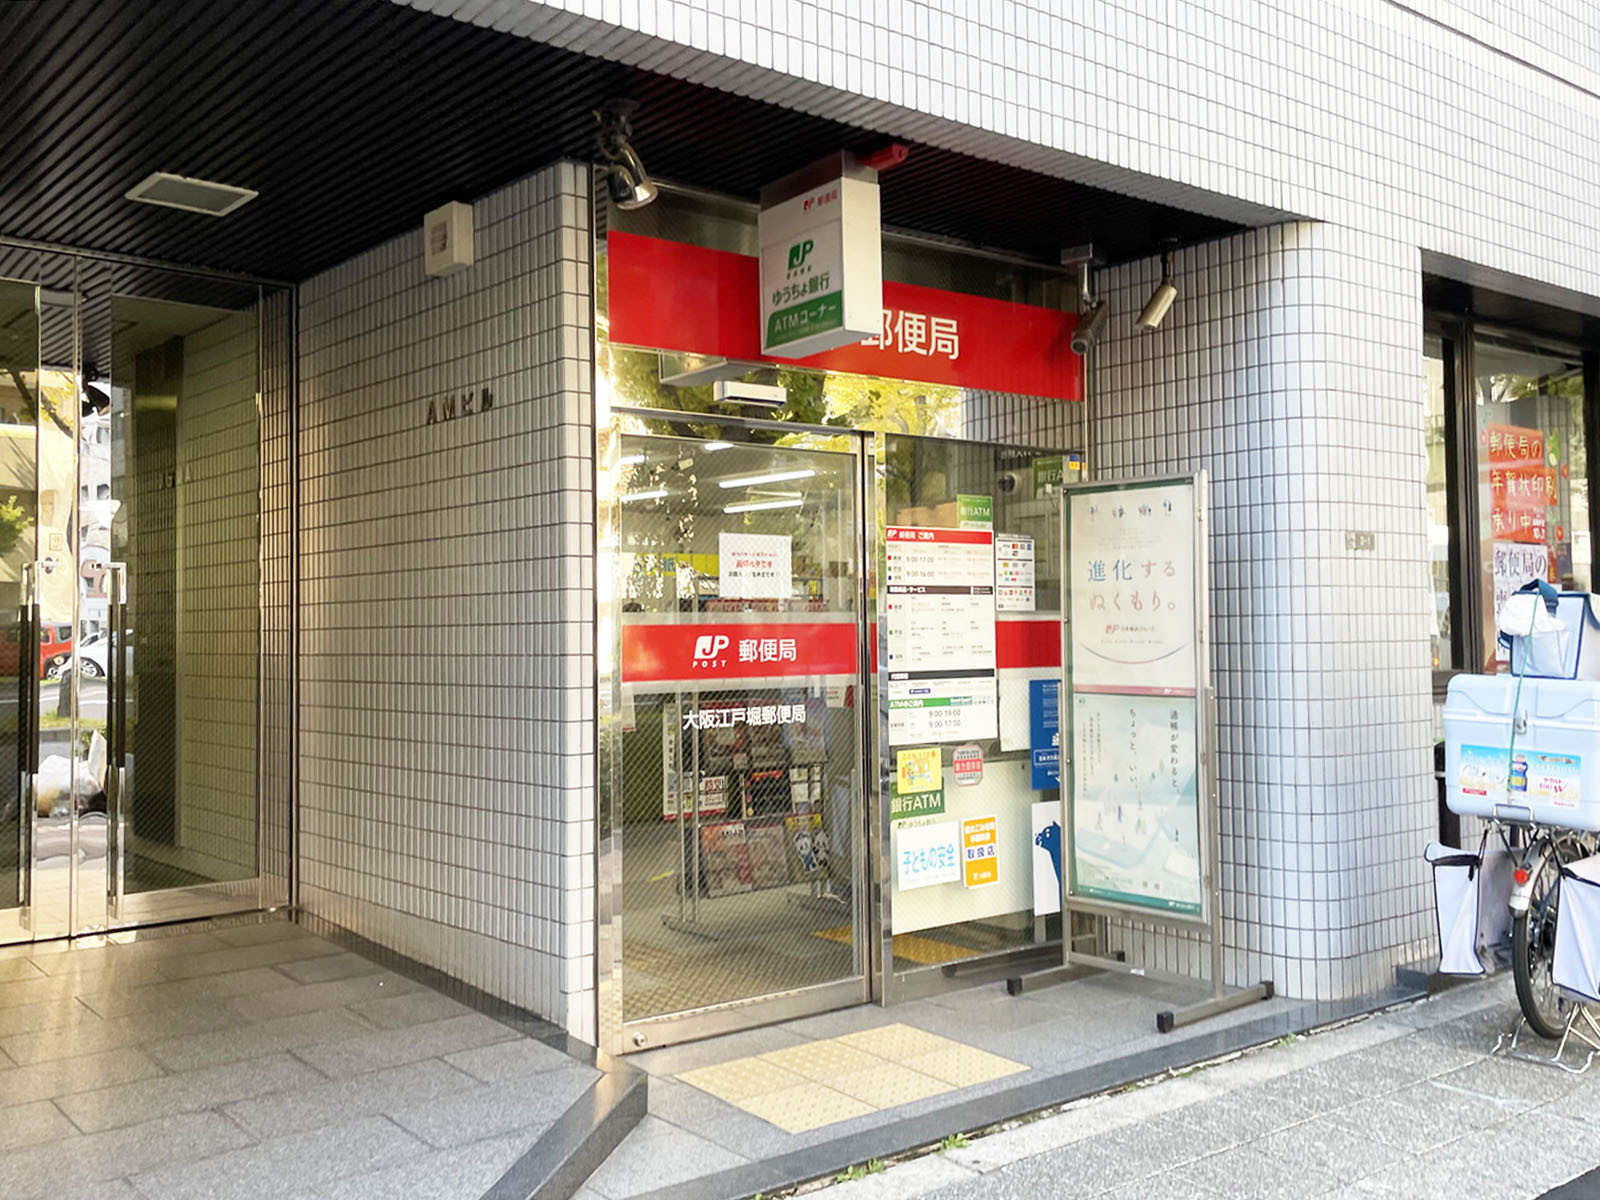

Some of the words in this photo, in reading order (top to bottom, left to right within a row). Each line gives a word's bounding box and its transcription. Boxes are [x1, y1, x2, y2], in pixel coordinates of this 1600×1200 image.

[772, 272, 830, 306] ゆうちょ銀行
[1489, 432, 1542, 458] 郵便局の
[1492, 509, 1531, 534] 承り中
[1088, 559, 1175, 582] 進化する
[1495, 549, 1547, 577] 郵便局の
[1089, 592, 1175, 611] ぬくもり。
[694, 635, 730, 660] JP
[738, 638, 797, 663] 郵便局
[692, 659, 728, 668] POST
[682, 704, 806, 731] 大阪江戸堀郵便局
[891, 793, 941, 813] 銀行ATM
[903, 844, 955, 874] 子どもの安全
